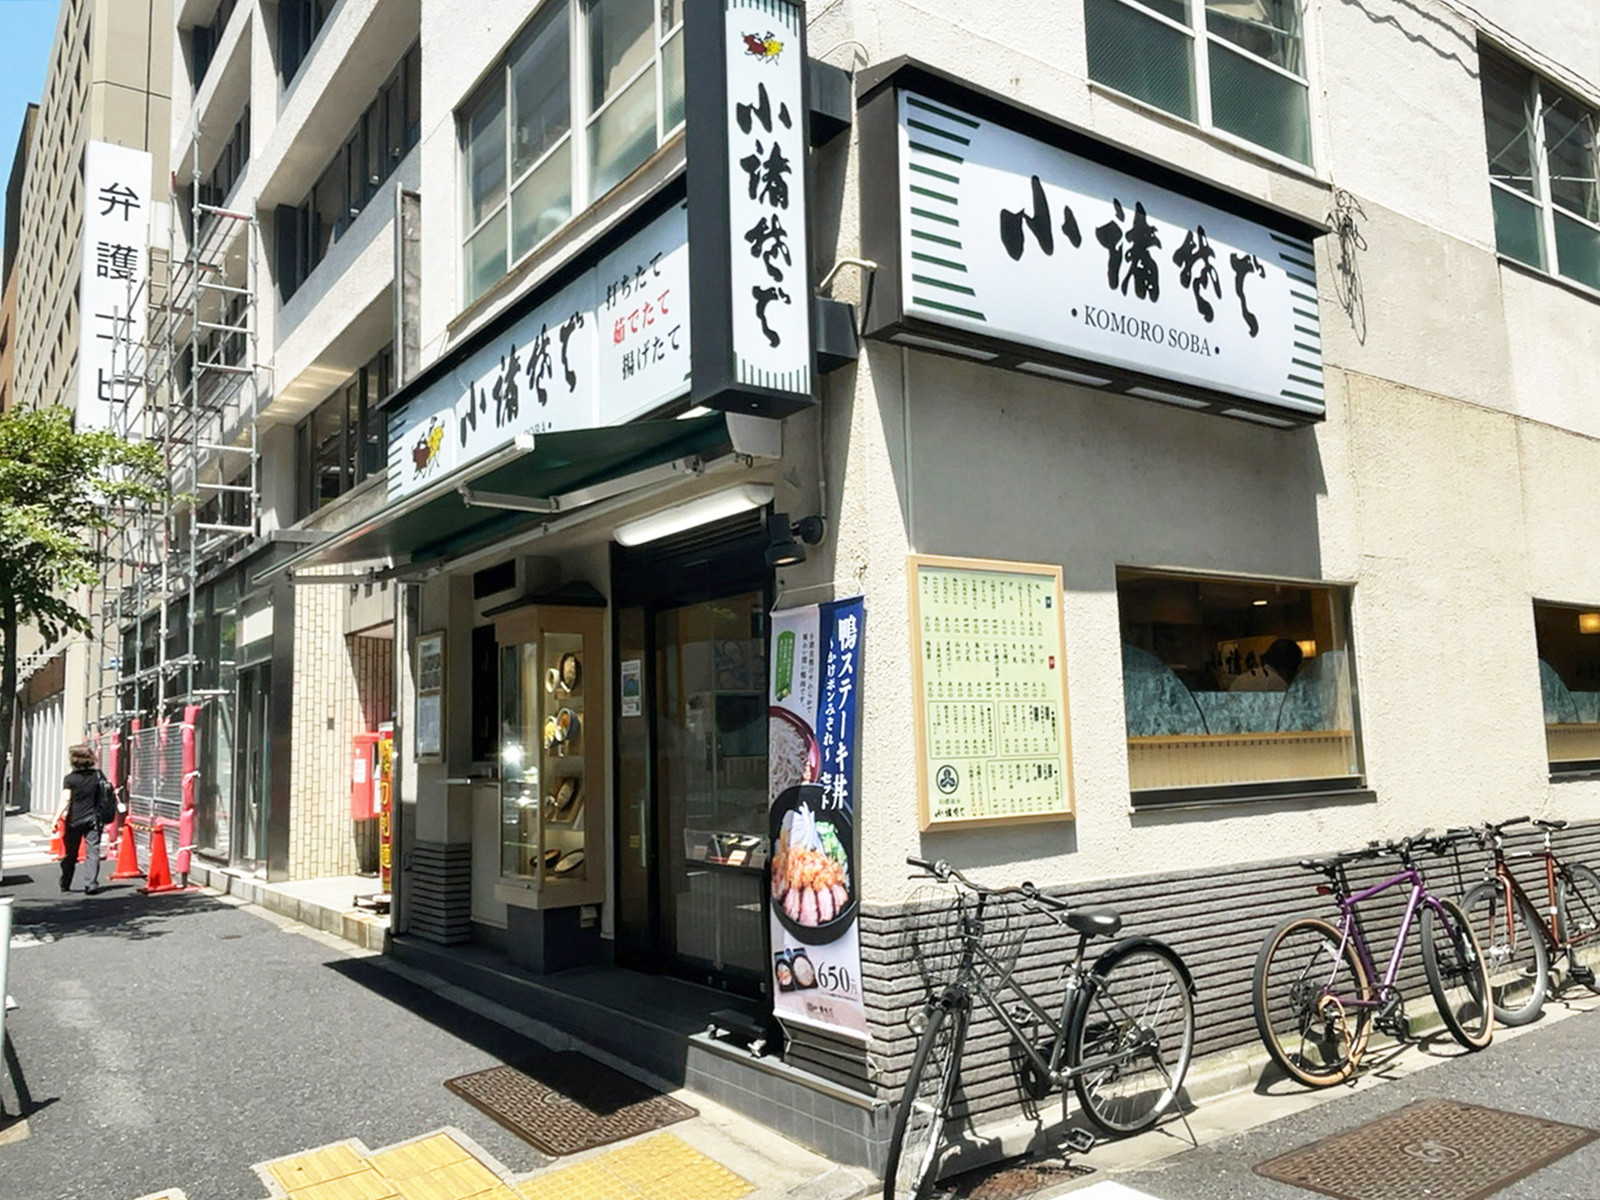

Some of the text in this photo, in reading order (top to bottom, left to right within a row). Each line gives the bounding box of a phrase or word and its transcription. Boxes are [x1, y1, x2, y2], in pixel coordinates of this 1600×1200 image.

[606, 251, 662, 311] 打ちたて
[613, 289, 670, 347] 茹でたて
[1084, 305, 1212, 357] KOMORO SOBA
[622, 325, 680, 381] 揚げたて
[831, 614, 858, 810] 鴨ステーキ丼
